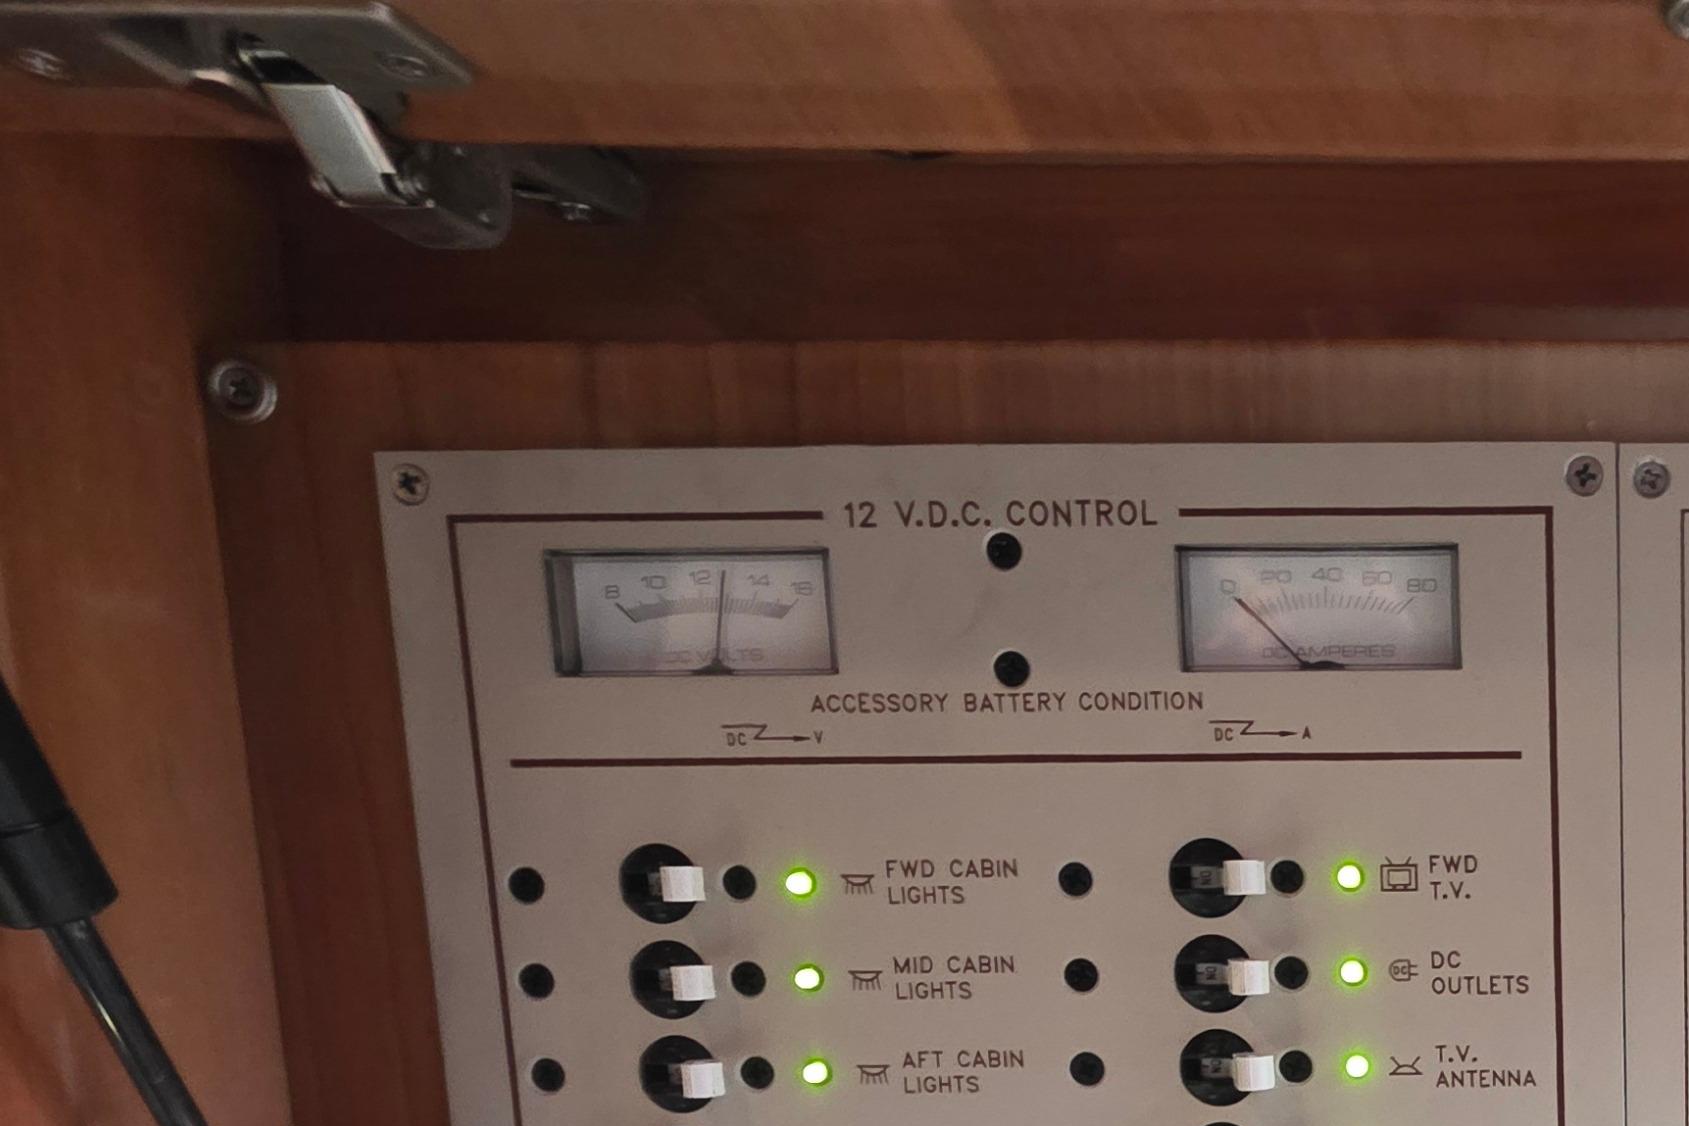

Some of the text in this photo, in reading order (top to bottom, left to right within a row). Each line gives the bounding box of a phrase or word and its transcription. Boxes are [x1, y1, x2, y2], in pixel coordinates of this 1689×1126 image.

[844, 499, 1158, 529] 12 V.D.C. CONTROL
[688, 569, 712, 586] 12
[746, 573, 771, 587] 14
[1259, 569, 1292, 585] 20
[1311, 567, 1345, 583] 40
[1406, 578, 1437, 592] 80
[810, 690, 1204, 714] ACCESSORY BATTERY CONDITION
[726, 731, 748, 747] DC
[1213, 727, 1234, 742] DC
[886, 858, 1019, 879] FWD CABIN
[1429, 854, 1478, 874] FWD
[887, 885, 965, 905] LIGHTS
[1429, 881, 1472, 901] T.V.
[892, 954, 1015, 974] MID CABIN
[1430, 950, 1461, 970] DC
[895, 980, 973, 1001] LIGHTS
[1431, 974, 1530, 996] OUTLETS
[902, 1049, 1025, 1069] AFT CABIN
[1434, 1044, 1478, 1063] T.V.
[903, 1074, 980, 1095] LIGHTS
[1435, 1069, 1537, 1089] ANTENNA
